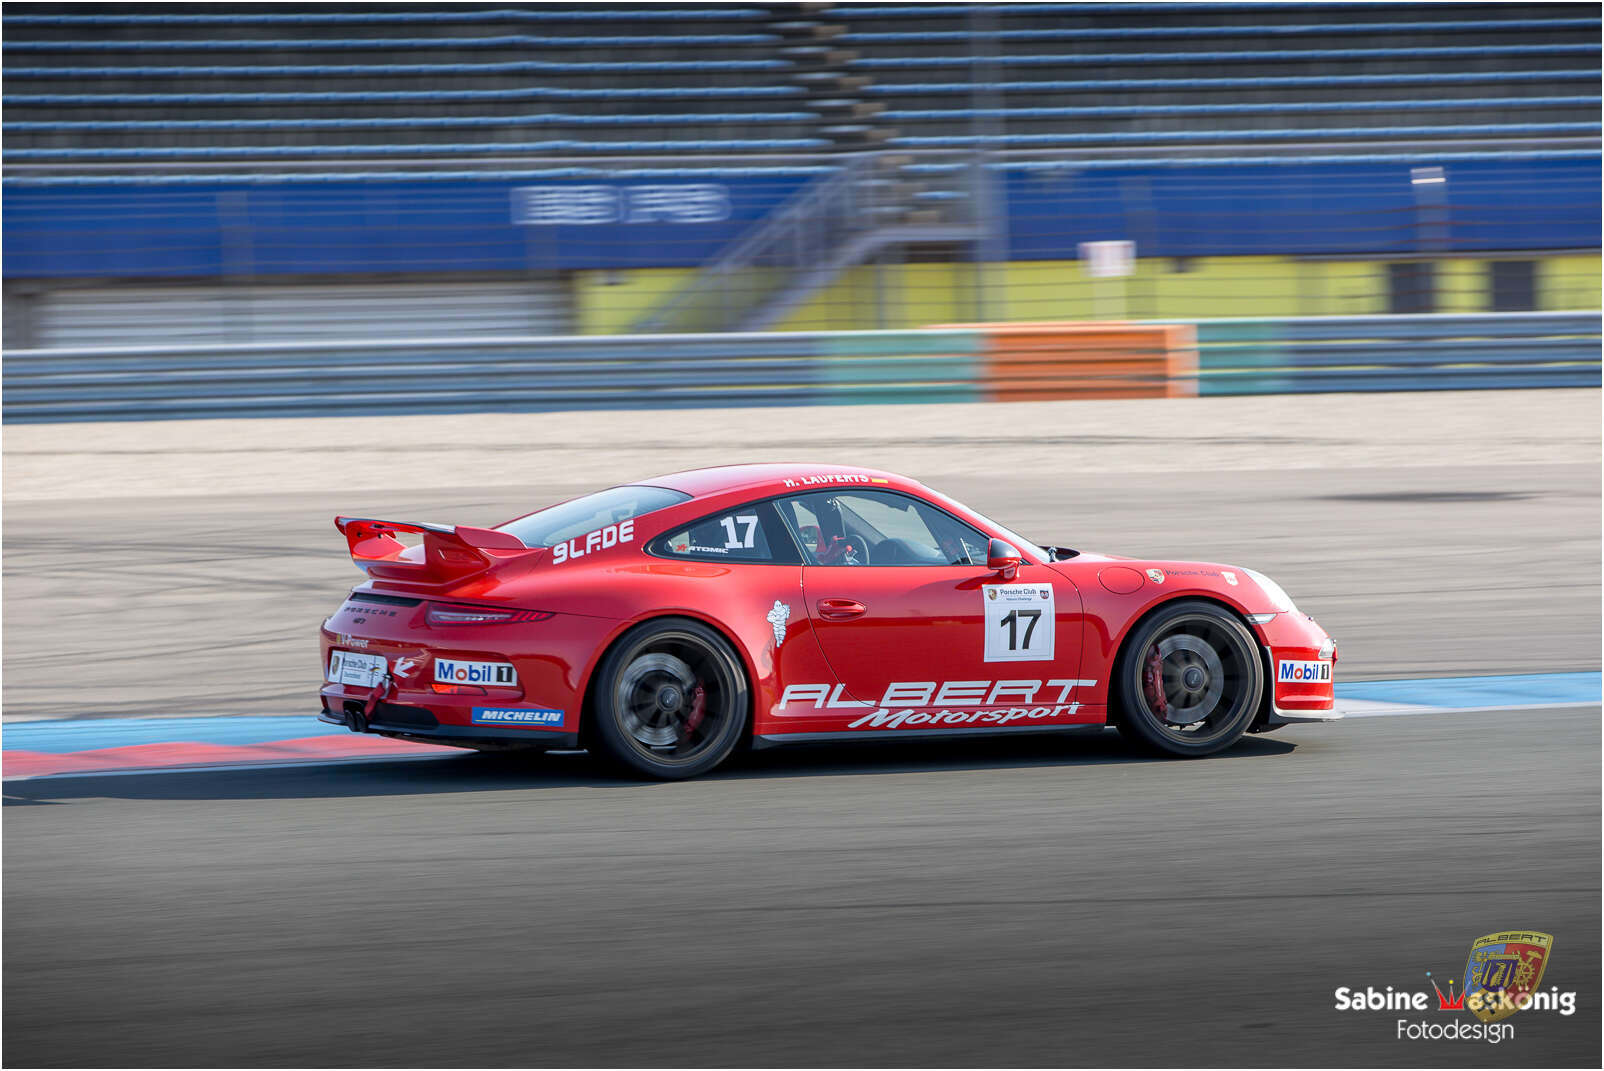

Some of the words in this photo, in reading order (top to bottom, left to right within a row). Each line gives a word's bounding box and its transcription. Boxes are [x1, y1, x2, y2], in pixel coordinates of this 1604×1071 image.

[719, 514, 759, 549] 17
[687, 545, 729, 554] ATOMIC
[1000, 609, 1042, 651] 17
[438, 662, 492, 682] Mobil
[498, 666, 511, 682] 1
[1281, 663, 1319, 680] Mobil
[1322, 664, 1329, 680] 1
[778, 679, 1098, 710] ALBERT
[481, 710, 562, 722] MICHELIN
[847, 701, 1086, 729] Motorsport
